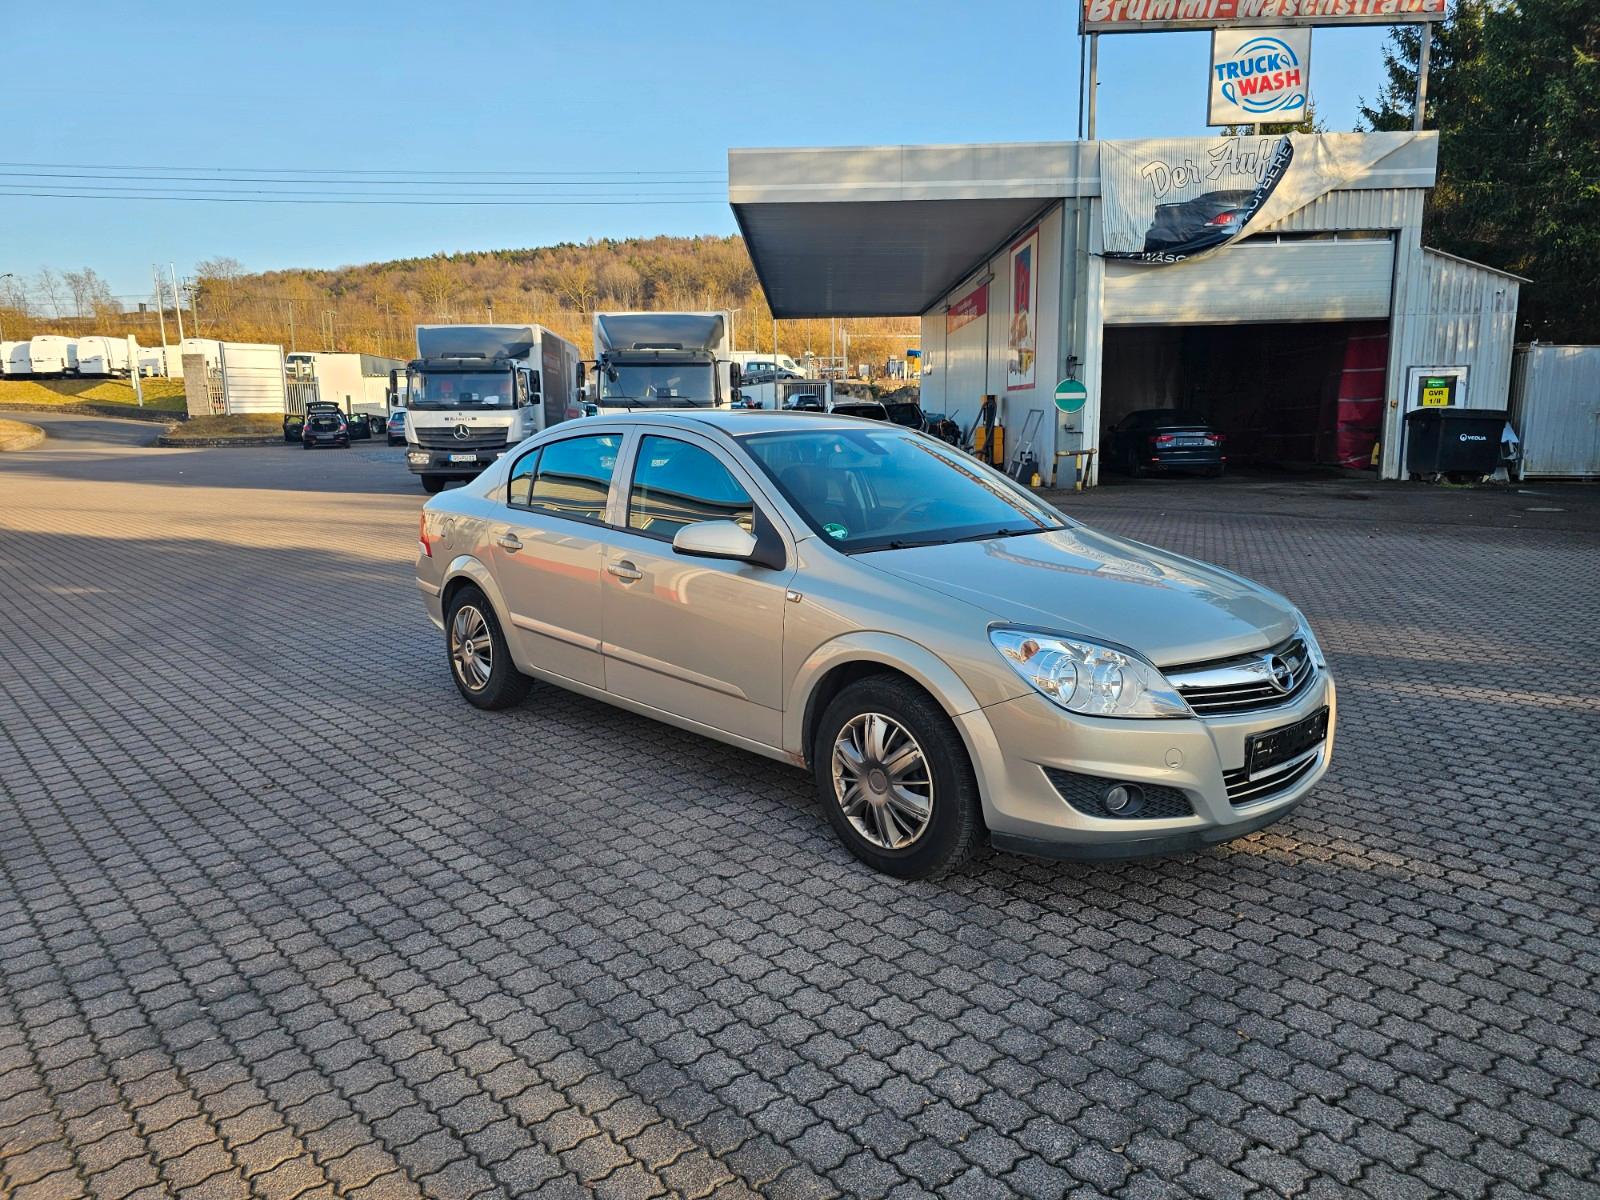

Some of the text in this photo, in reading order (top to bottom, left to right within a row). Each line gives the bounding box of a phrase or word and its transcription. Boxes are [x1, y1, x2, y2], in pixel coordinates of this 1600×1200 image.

[1215, 53, 1281, 81] TRUCK
[1237, 69, 1301, 97] WASH
[1142, 160, 1201, 199] Der
